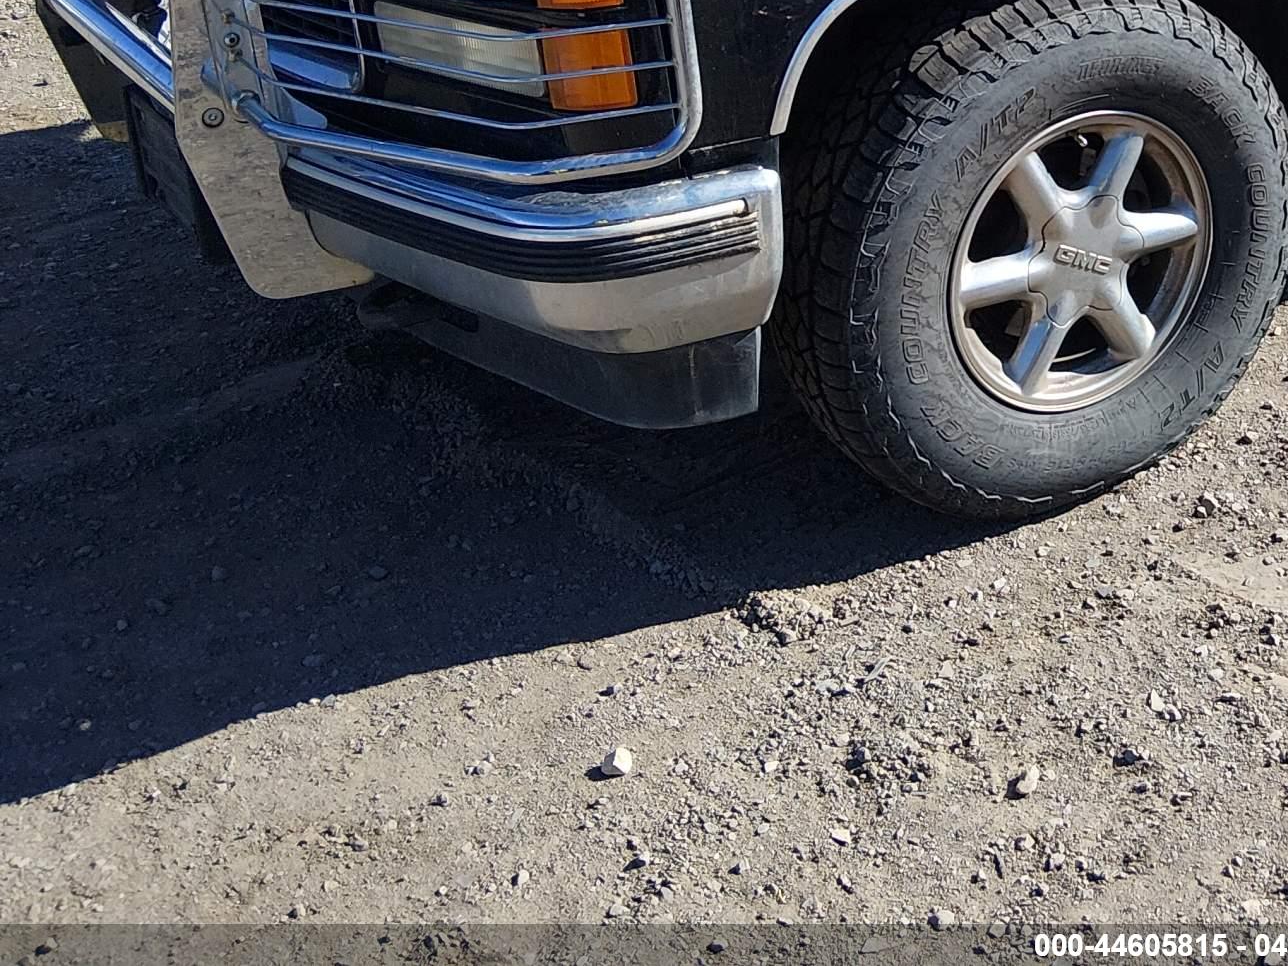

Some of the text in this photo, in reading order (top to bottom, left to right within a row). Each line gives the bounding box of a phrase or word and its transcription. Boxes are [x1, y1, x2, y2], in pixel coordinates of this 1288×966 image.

[900, 86, 1036, 471] BACK COUNTRY A/T2
[1053, 243, 1113, 275] GMC
[1158, 76, 1272, 432] BACK COUNTRY A/T2
